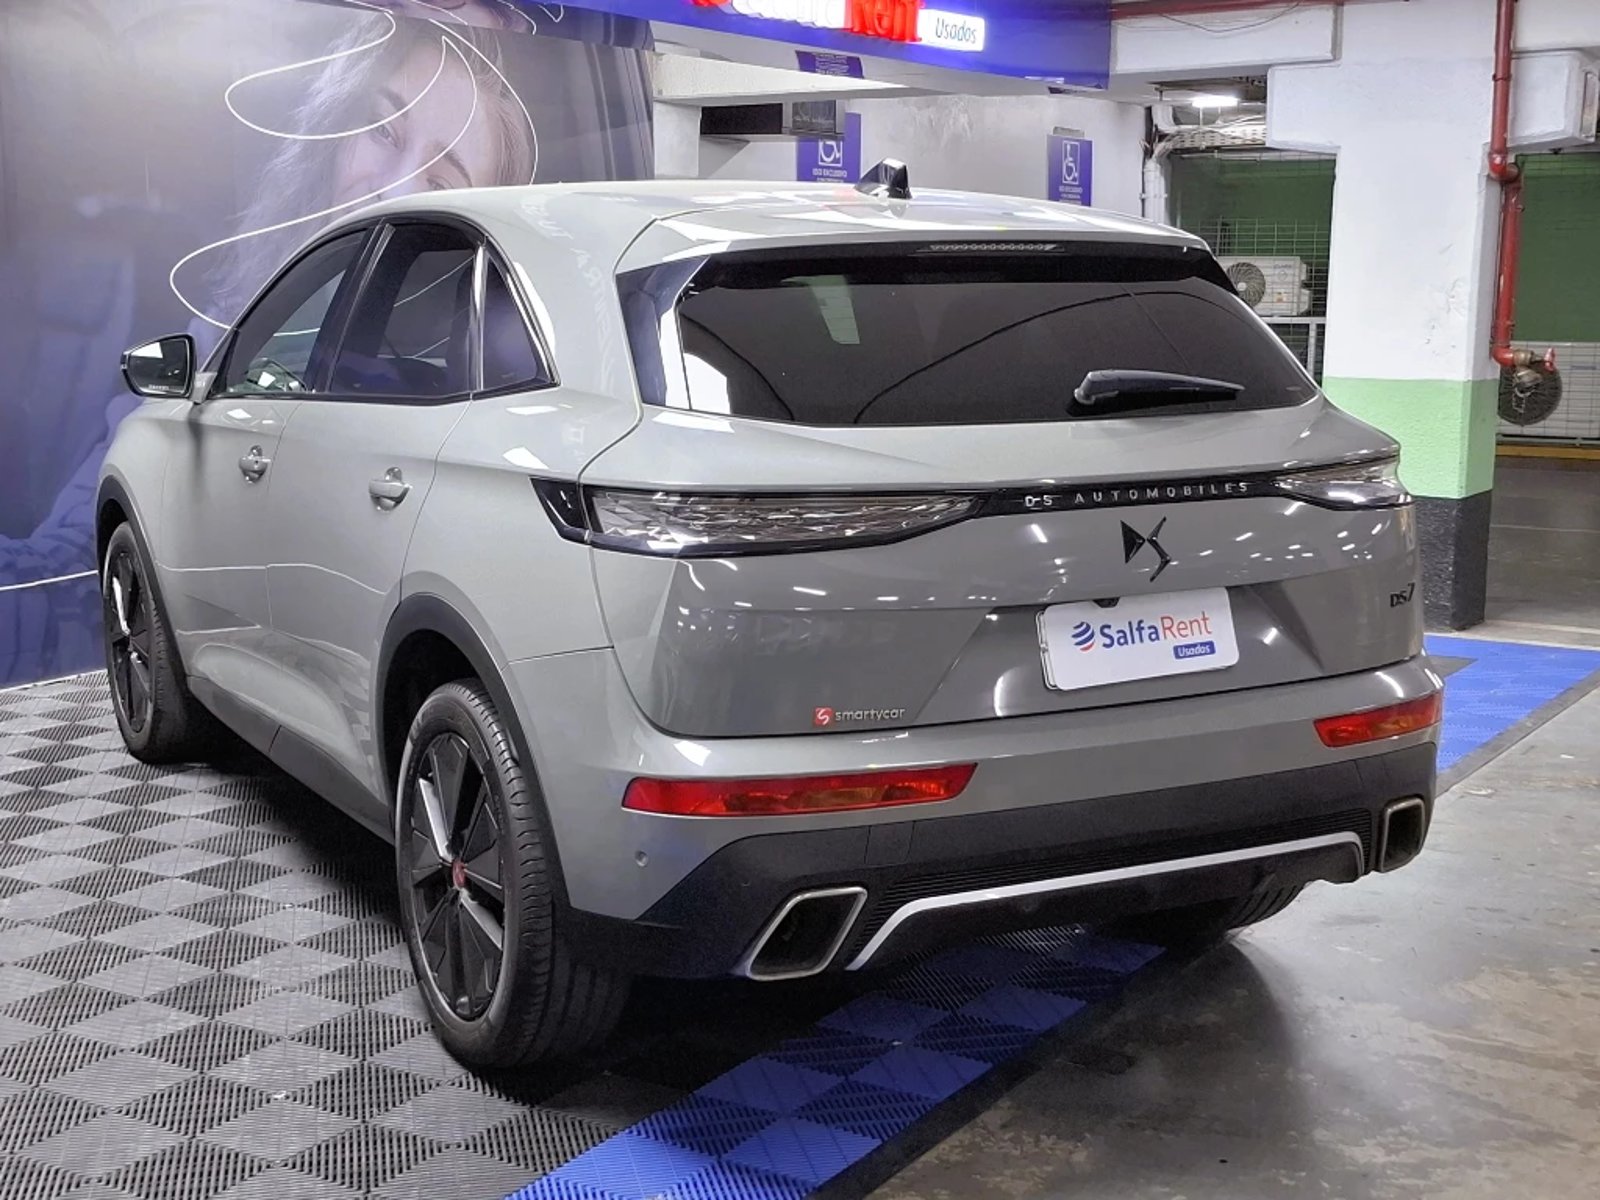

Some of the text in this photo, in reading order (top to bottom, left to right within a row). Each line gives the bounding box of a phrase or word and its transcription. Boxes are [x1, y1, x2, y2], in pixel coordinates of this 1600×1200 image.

[935, 17, 977, 44] Usados
[1024, 482, 1248, 508] DS AUTOMOBILES
[1100, 611, 1212, 649] SalfaRent
[1177, 644, 1211, 657] Usados
[835, 708, 906, 721] smartycar
